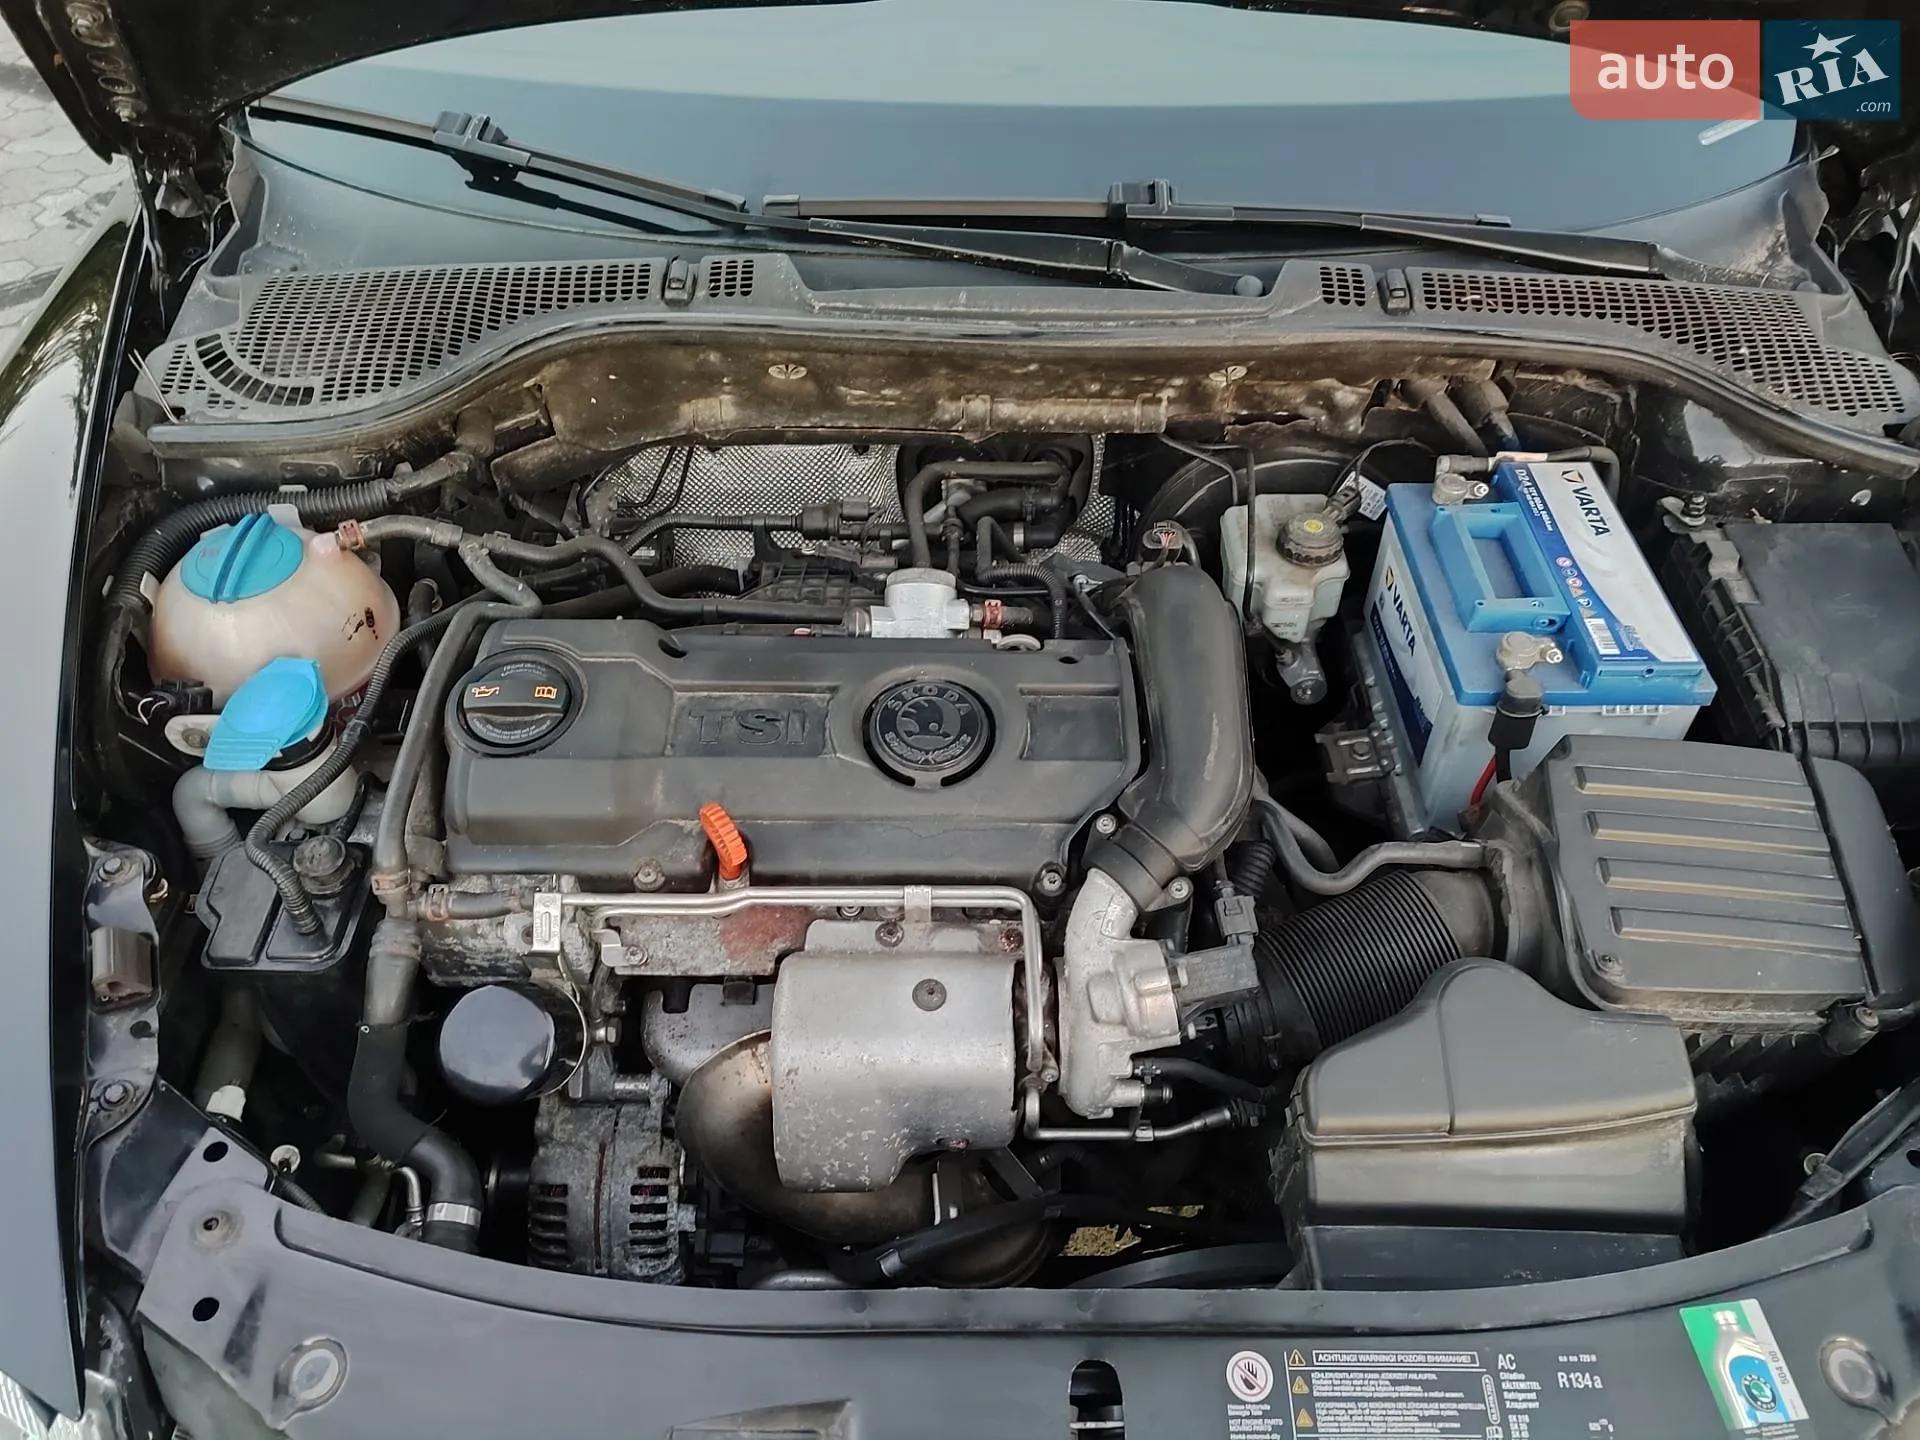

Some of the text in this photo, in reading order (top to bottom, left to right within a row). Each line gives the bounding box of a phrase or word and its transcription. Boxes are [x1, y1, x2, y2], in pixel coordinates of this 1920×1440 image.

[1572, 486, 1611, 537] VARTA
[1392, 585, 1417, 656] VARTA
[688, 708, 806, 746] TSI
[1498, 1353, 1517, 1370] AC
